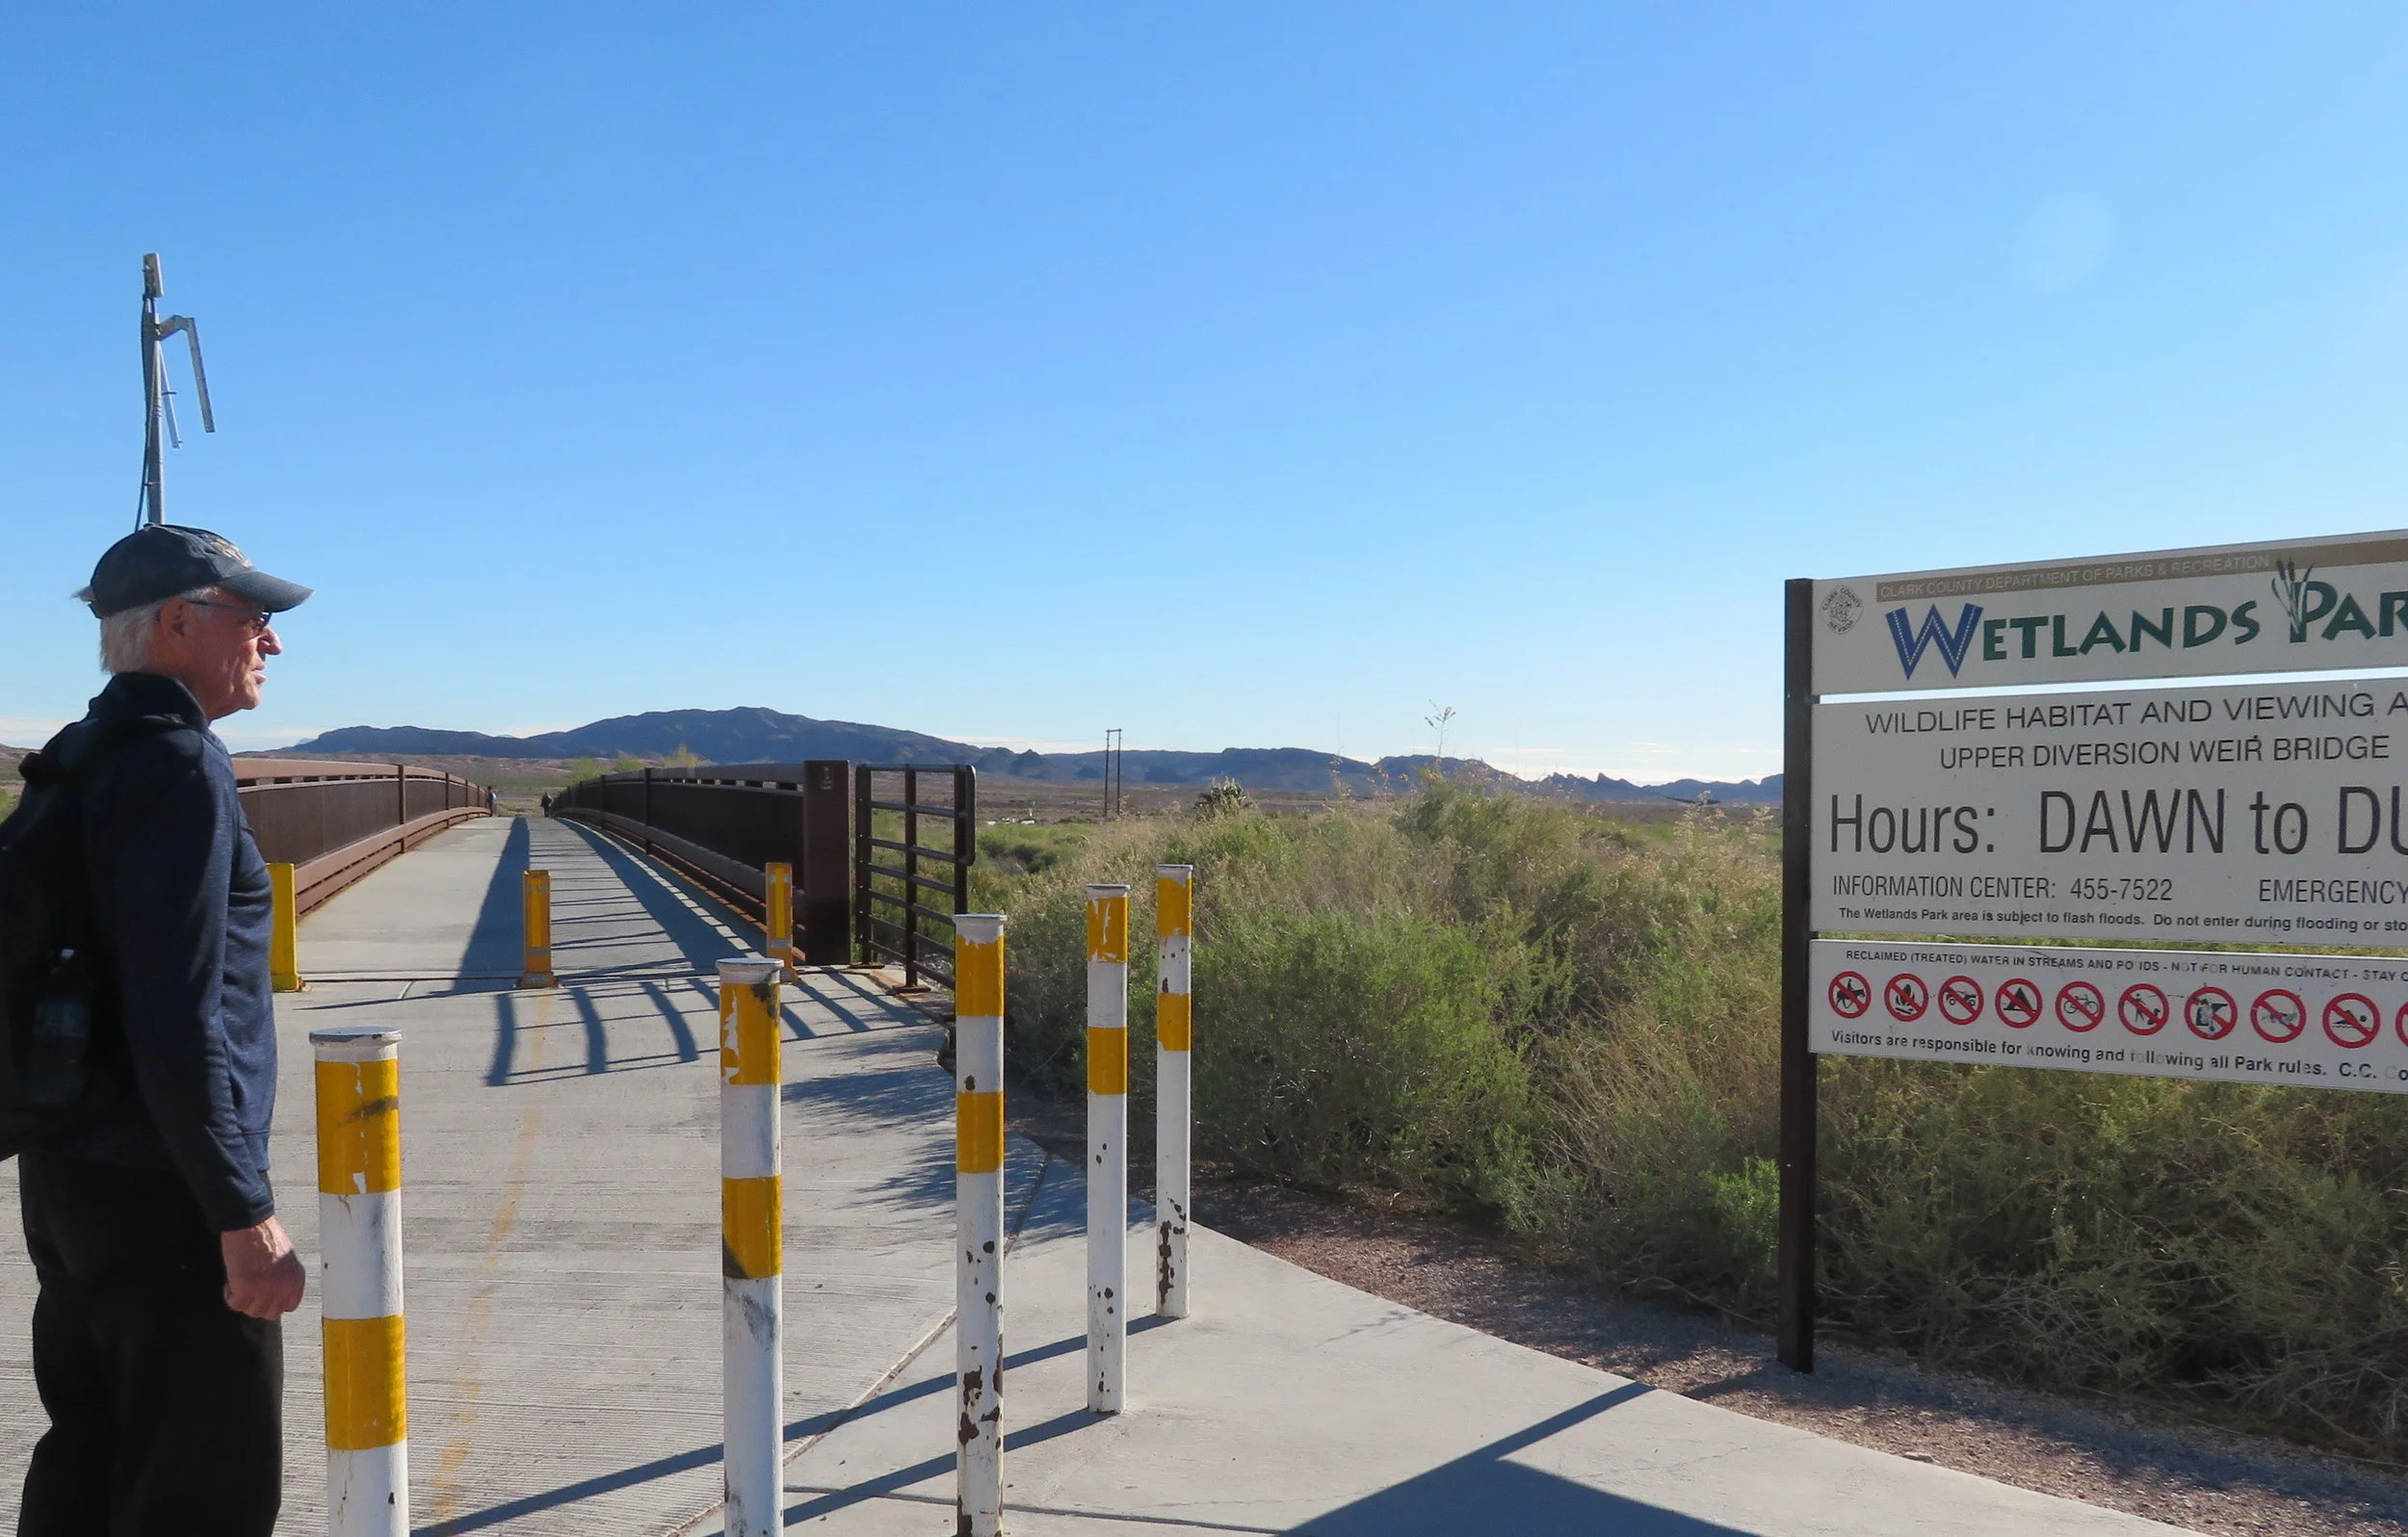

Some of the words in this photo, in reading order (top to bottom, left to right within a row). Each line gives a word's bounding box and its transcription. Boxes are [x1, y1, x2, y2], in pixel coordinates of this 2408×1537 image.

[2082, 569, 2102, 582] OF
[2106, 563, 2154, 579] PARKS
[1865, 708, 1996, 734] WILDLIFE
[2006, 702, 2132, 729] HABITAT
[2140, 698, 2212, 723] AND
[2223, 691, 2375, 720] VIEWING
[1940, 745, 2025, 769] UPPER
[2033, 740, 2180, 767] DIVERSION
[2189, 738, 2264, 763] WEIR
[2273, 735, 2390, 761] BRIDGE
[1830, 794, 1995, 854] Hours:
[2039, 789, 2225, 854] DAWN
[2249, 790, 2309, 855] to
[1832, 874, 1963, 898] INFORMATION
[1970, 875, 2056, 899] CENTER:
[2070, 877, 2173, 901] 455-7522
[2258, 878, 2408, 904] EMERGENCY
[1839, 907, 1861, 920] The
[1864, 907, 1918, 921] Wetlands
[1921, 908, 1949, 921] Park
[1951, 912, 1978, 922] area
[1982, 910, 1993, 922] is
[1997, 910, 2043, 925] subject
[2047, 912, 2059, 924] to
[2063, 912, 2095, 925] flash
[2099, 912, 2145, 925] floods.
[2153, 914, 2170, 926] Do
[2176, 915, 2199, 926] not
[2203, 916, 2239, 927] enter
[2244, 916, 2291, 931] during
[2296, 917, 2358, 933] flooding
[2363, 921, 2379, 931] or
[1845, 950, 1908, 962] RECLAIMED
[1910, 951, 1968, 965] (TREATED)
[1971, 954, 2009, 966] WATER
[2013, 955, 2025, 967] IN
[2028, 956, 2084, 969] STREAMS
[2087, 958, 2113, 970] AND
[2231, 964, 2281, 977] HUMAN
[2284, 965, 2349, 979] CONTACT
[2362, 969, 2397, 981] STAY
[1831, 1030, 1882, 1046] Visitors
[1886, 1035, 1908, 1047] are
[1912, 1037, 1997, 1054] responsible
[2002, 1040, 2023, 1055] for
[2027, 1043, 2090, 1063] knowing
[2095, 1048, 2125, 1061] and
[2211, 1055, 2229, 1069] all
[2235, 1055, 2273, 1073] Park
[2278, 1059, 2327, 1076] rules.
[2339, 1062, 2377, 1080] C.C.
